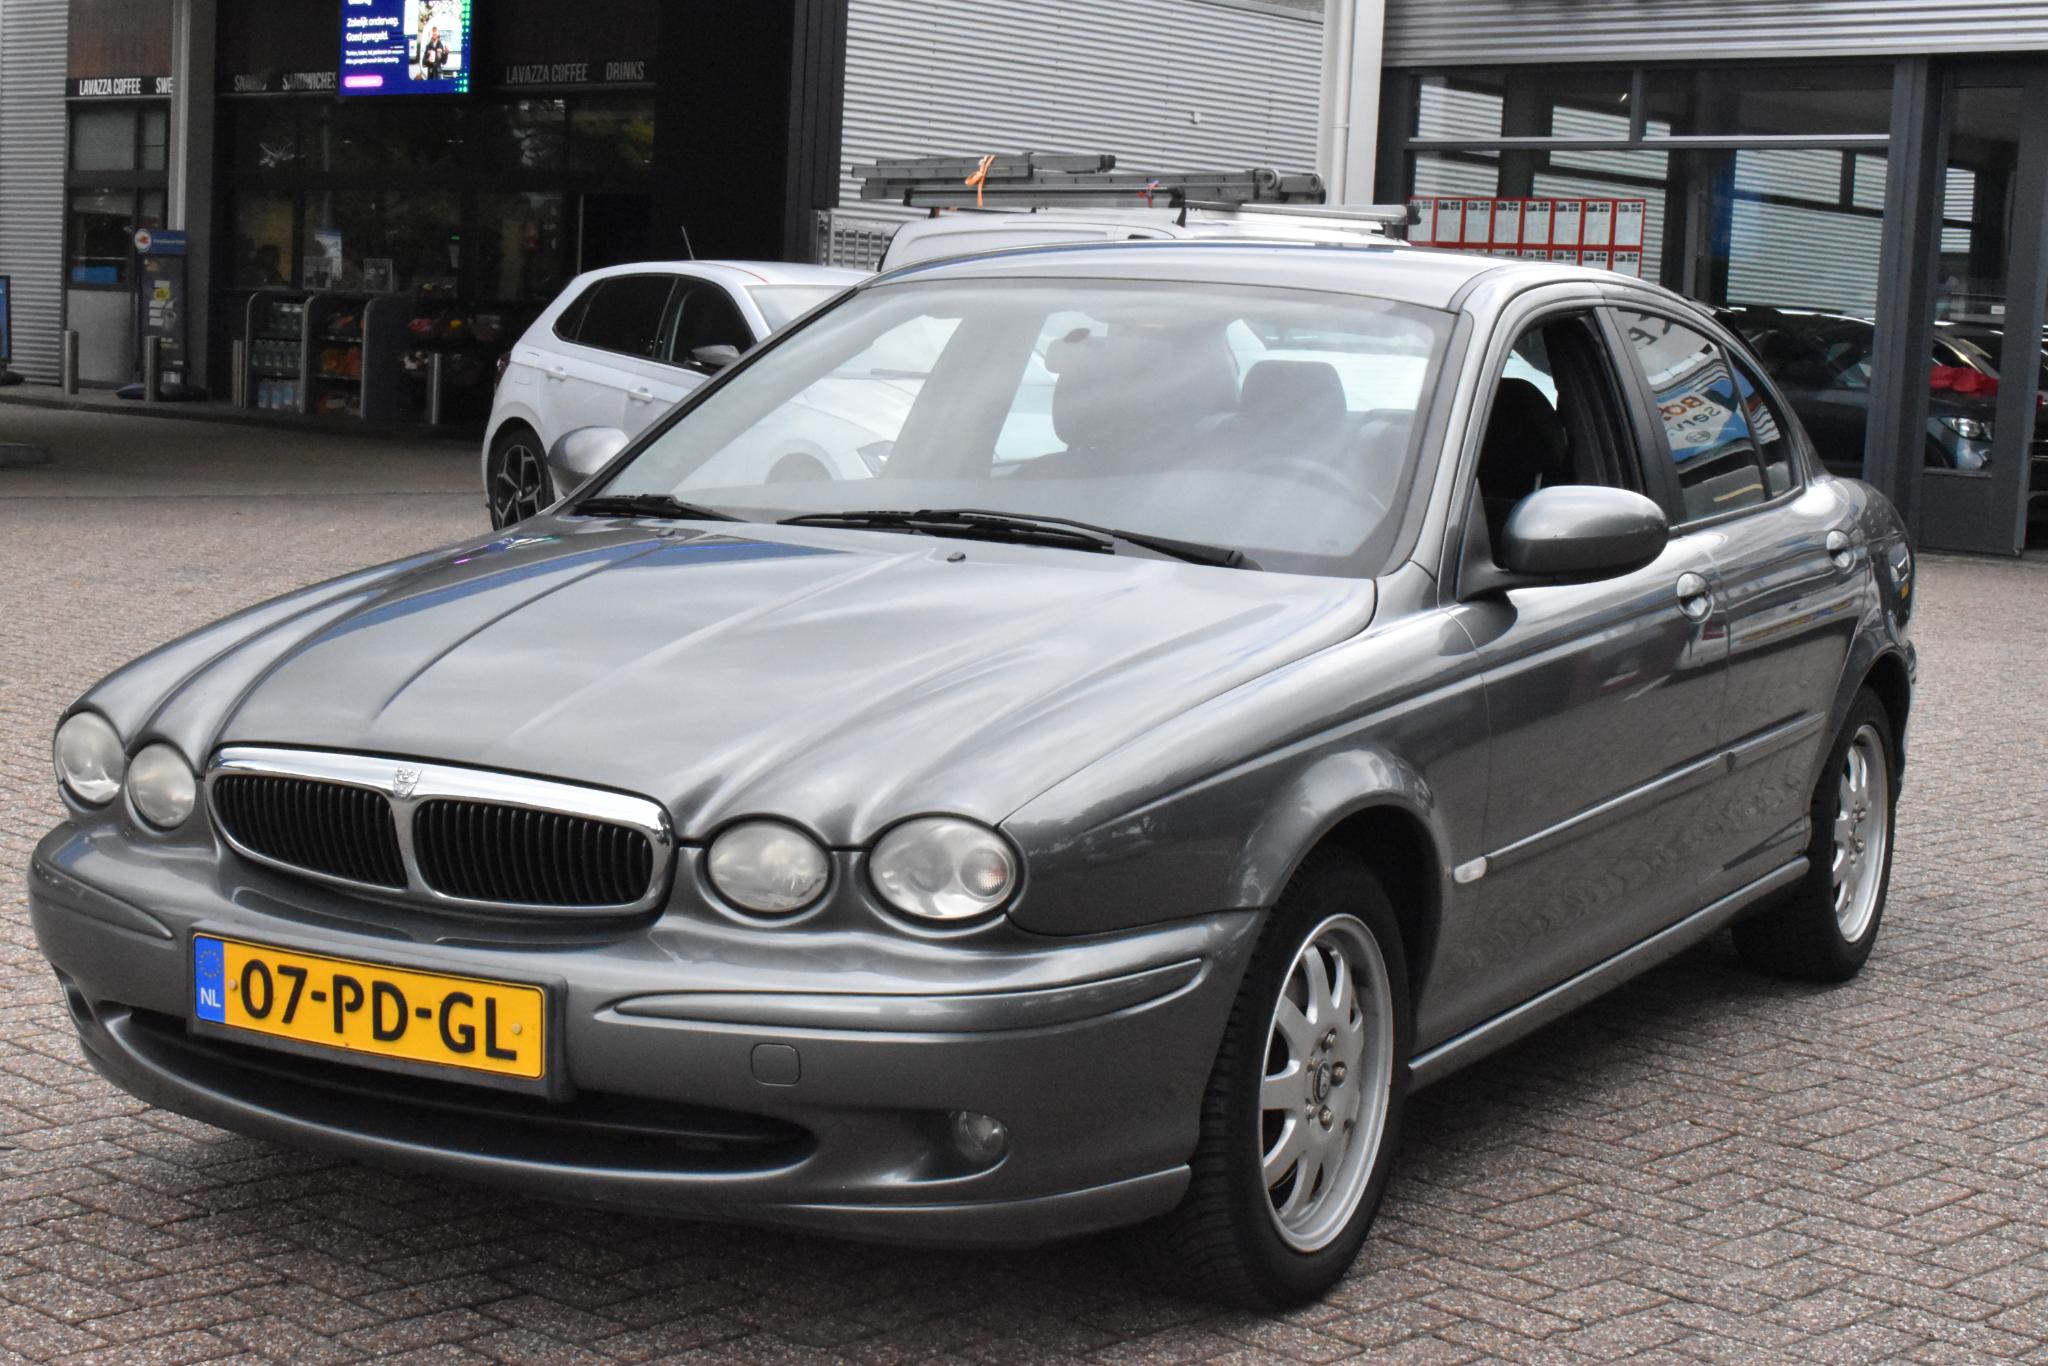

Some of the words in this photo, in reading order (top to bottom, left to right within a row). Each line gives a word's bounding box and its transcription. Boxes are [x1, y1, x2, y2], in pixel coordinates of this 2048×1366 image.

[506, 64, 549, 84] LAVAZZA
[551, 63, 589, 82] COFFEE
[605, 61, 645, 80] DRINKS
[79, 79, 112, 95] LAVAZZA
[113, 78, 141, 94] COFFEE
[200, 987, 222, 1009] NL
[240, 958, 518, 1062] 07-PD-GL
